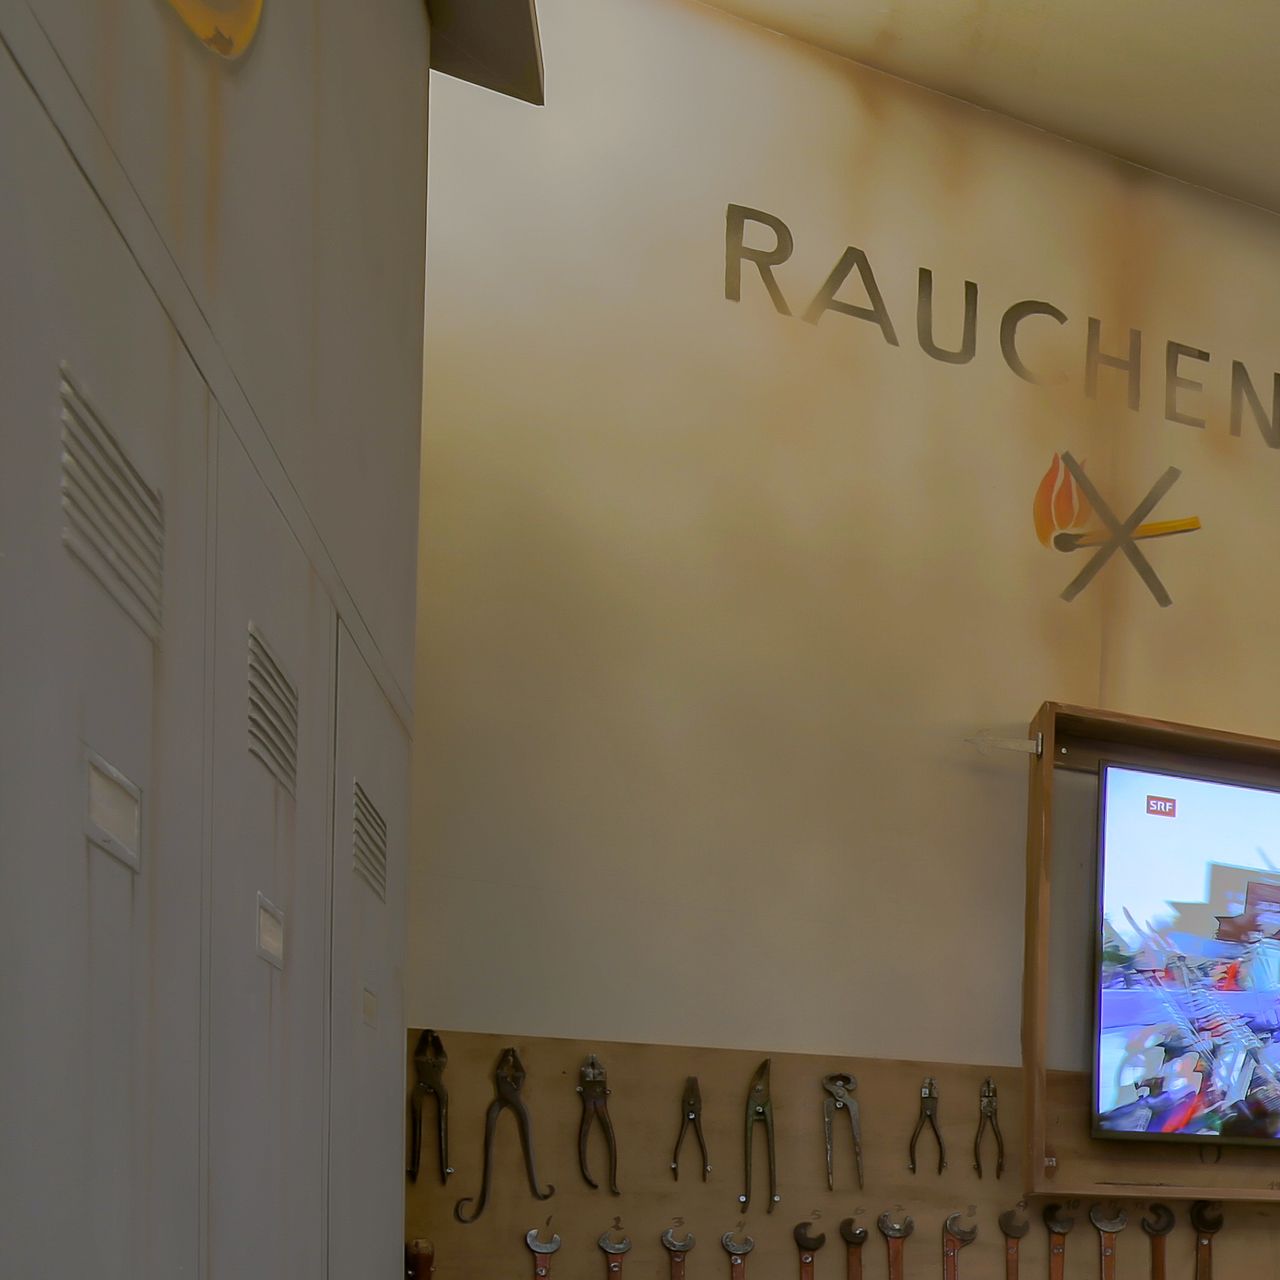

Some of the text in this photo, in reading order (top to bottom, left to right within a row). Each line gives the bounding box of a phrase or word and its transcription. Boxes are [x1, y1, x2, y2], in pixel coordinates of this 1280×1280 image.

[1149, 799, 1174, 813] SRF
[810, 1208, 823, 1221] 5
[610, 1215, 625, 1232] 2
[671, 1215, 686, 1229] 3
